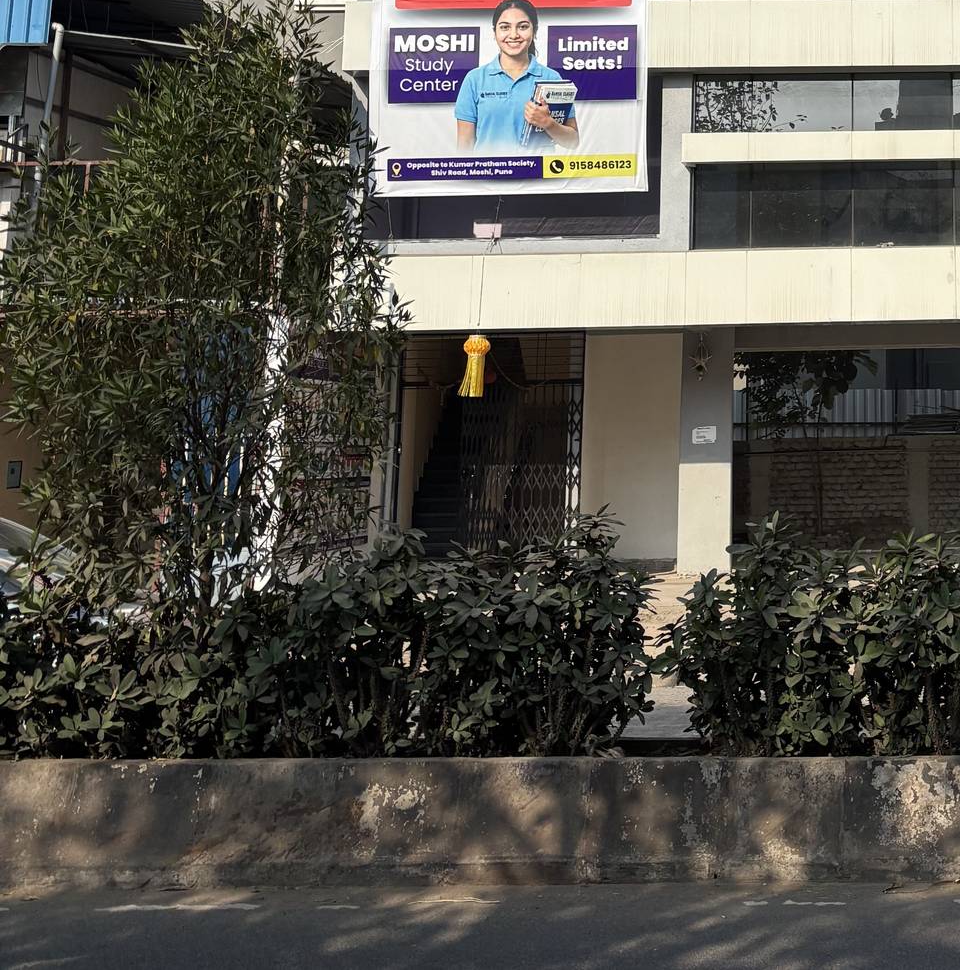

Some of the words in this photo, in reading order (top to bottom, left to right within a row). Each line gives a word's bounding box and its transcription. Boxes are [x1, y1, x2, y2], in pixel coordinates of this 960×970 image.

[394, 34, 475, 53] MOSHI
[558, 36, 629, 52] Limited
[405, 59, 454, 75] Study
[562, 56, 623, 71] Seats!
[400, 78, 458, 92] Center
[406, 162, 439, 170] Opposite
[569, 160, 632, 170] 9158486123
